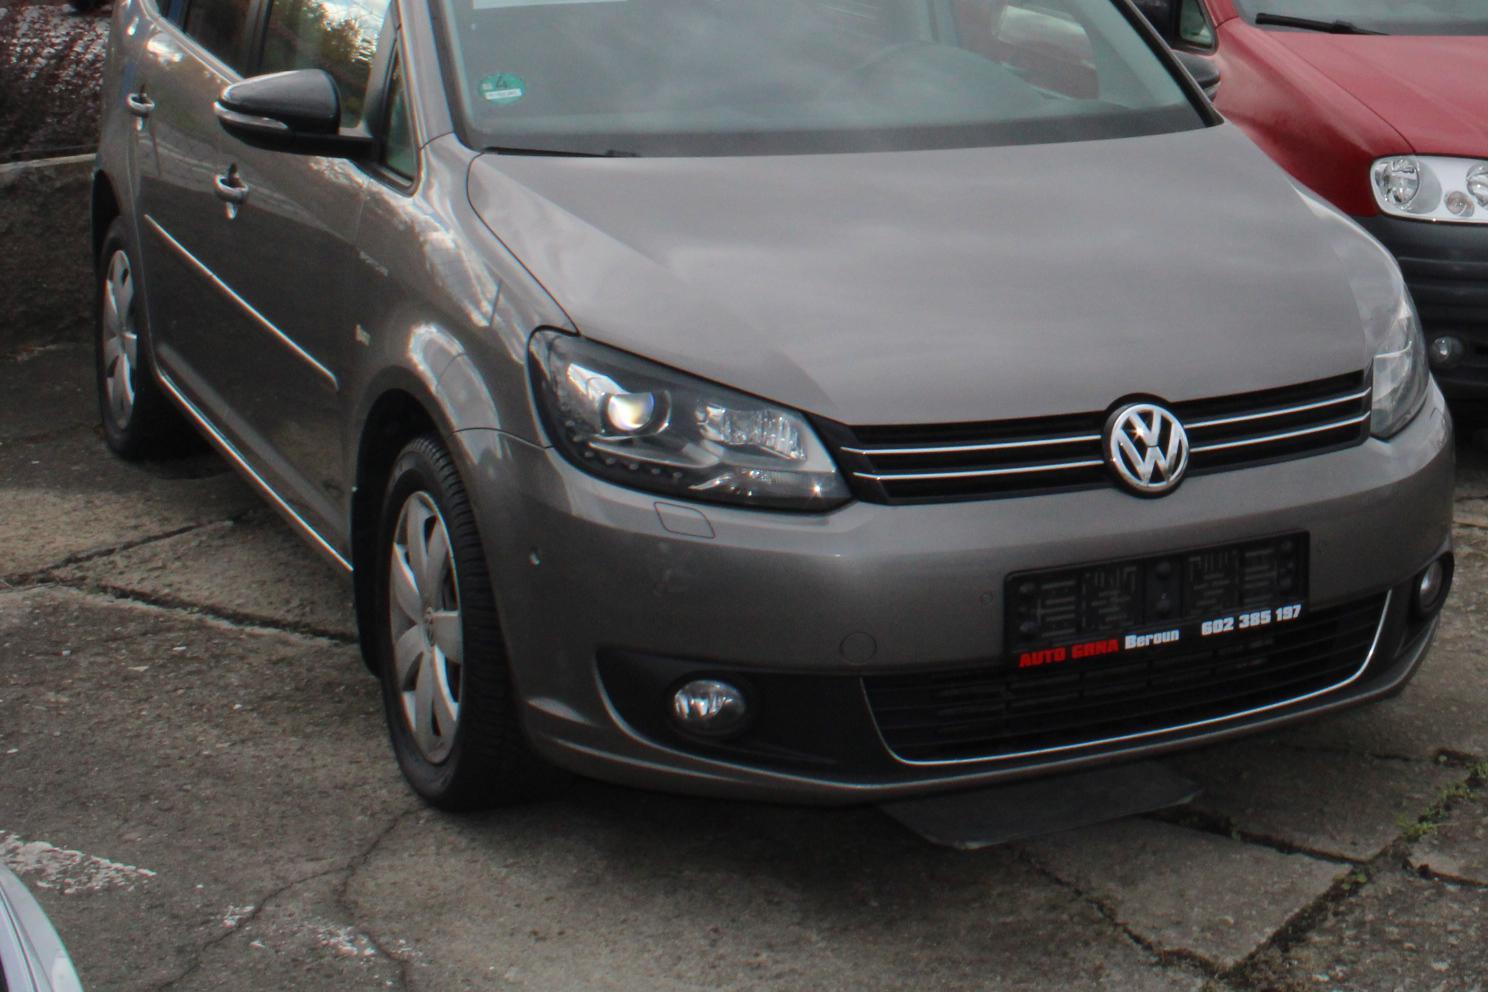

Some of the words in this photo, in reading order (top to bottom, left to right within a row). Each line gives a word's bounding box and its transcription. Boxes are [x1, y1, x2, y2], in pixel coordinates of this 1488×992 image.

[1019, 646, 1066, 668] AUTO
[1124, 629, 1180, 650] Beroun
[1201, 617, 1234, 636] 602
[1238, 609, 1272, 629] 385
[1275, 604, 1302, 622] 197
